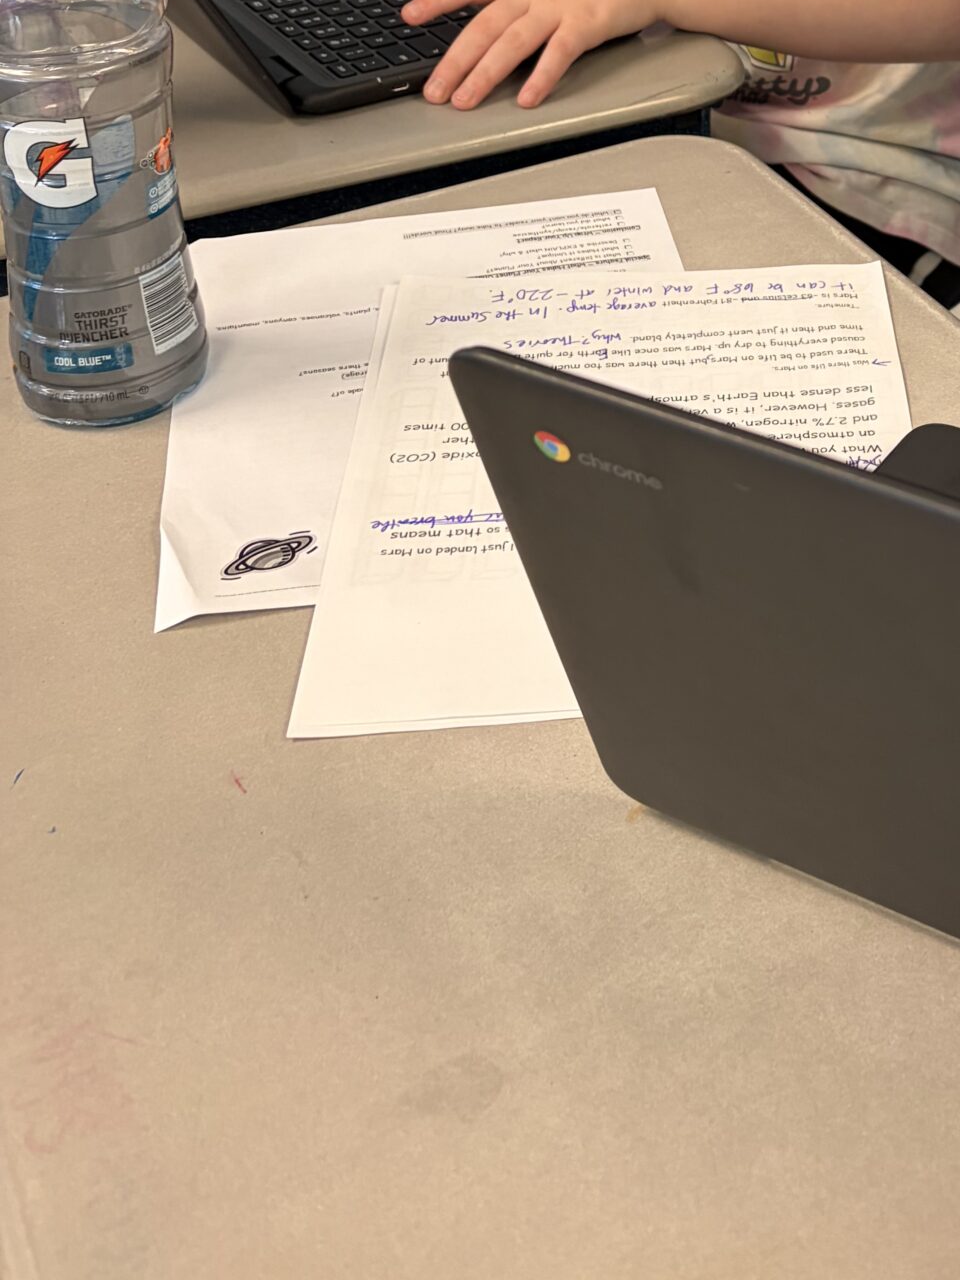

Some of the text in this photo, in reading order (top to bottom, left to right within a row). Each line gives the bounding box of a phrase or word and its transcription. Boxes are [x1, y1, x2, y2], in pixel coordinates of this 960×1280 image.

[662, 284, 694, 296] and
[767, 282, 784, 293] be
[796, 280, 827, 291] can
[574, 289, 596, 300] at
[661, 291, 858, 308] Mars Fahrenheit
[606, 297, 657, 312] average
[495, 310, 523, 321] the
[528, 307, 548, 319] In
[75, 313, 128, 331] THIRST
[59, 326, 129, 344] QUENCHER
[582, 328, 621, 346] Why?
[629, 323, 864, 344] time and then just went completely bland.
[524, 335, 866, 362] caused everything to dry up. Mars was once like Earth for quite
[836, 347, 869, 358] There
[740, 355, 755, 363] on
[757, 354, 778, 364] life
[779, 353, 794, 362] be
[794, 352, 807, 361] to
[809, 350, 834, 360] used
[54, 356, 76, 367] COOL
[583, 363, 602, 371] too
[605, 362, 626, 370] was
[628, 360, 659, 370] there
[661, 358, 687, 369] then
[810, 363, 826, 371] life
[828, 360, 851, 370] there
[702, 384, 873, 404] less dense than Earth's
[759, 402, 828, 414] However,
[831, 397, 876, 411] gases.
[403, 422, 445, 432] times
[740, 413, 878, 429] and 2.7% nitrogen,
[768, 429, 876, 443] an atmosphere
[811, 443, 883, 455] What you
[389, 450, 437, 464] (CO2)
[577, 451, 663, 490] chrome
[390, 526, 501, 540] so that means
[380, 540, 510, 558] just landed on Mars
